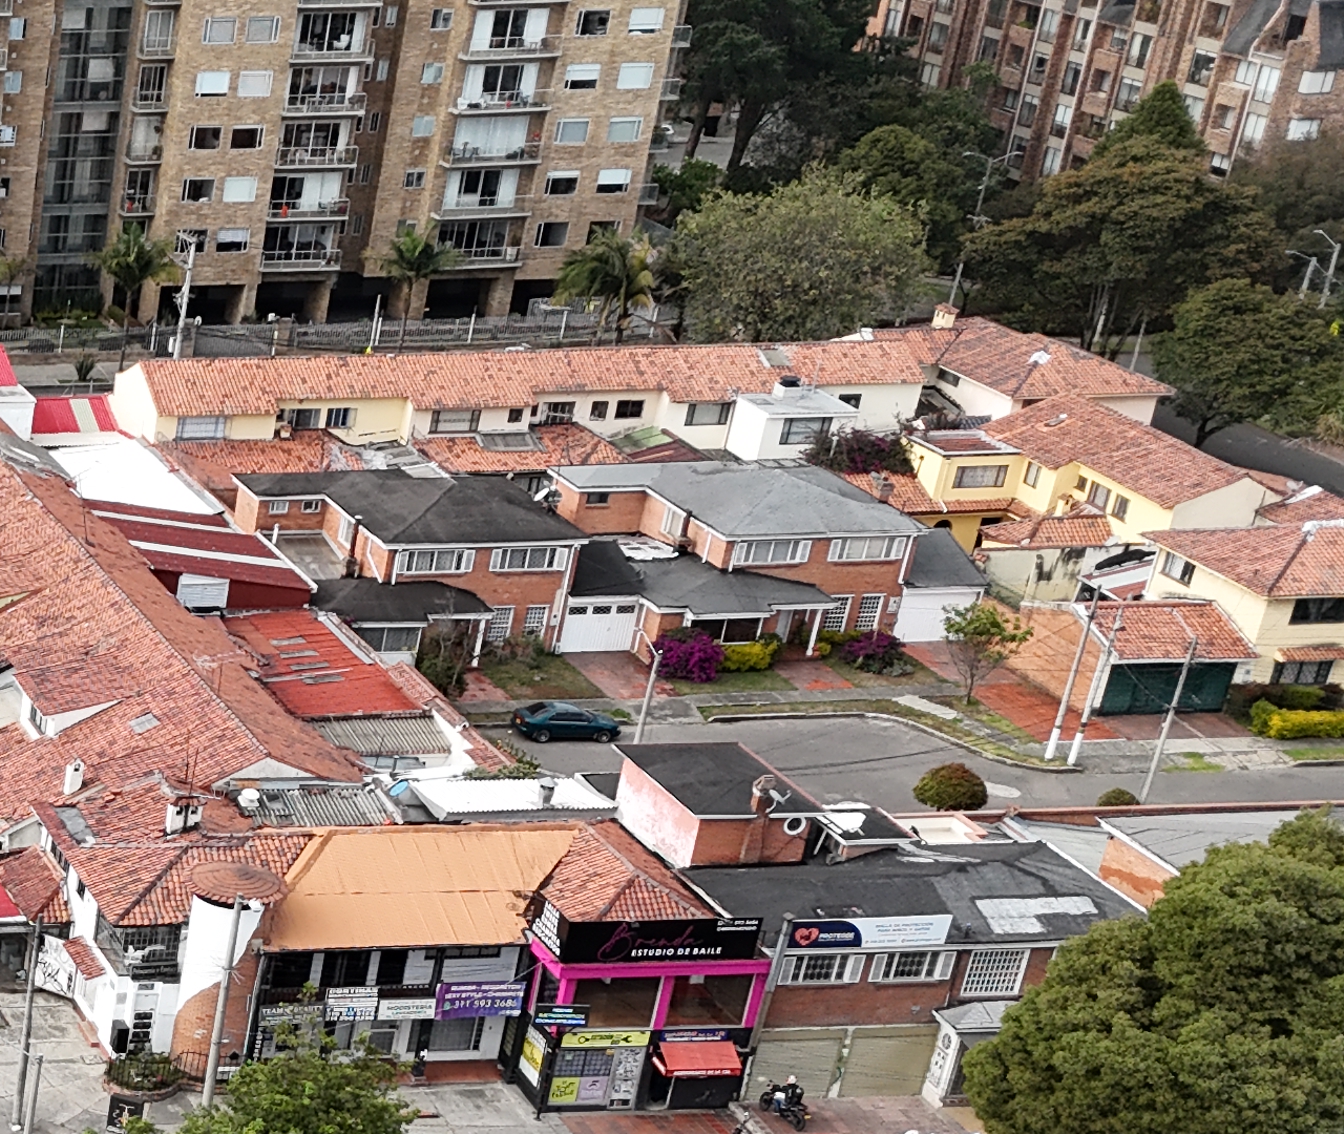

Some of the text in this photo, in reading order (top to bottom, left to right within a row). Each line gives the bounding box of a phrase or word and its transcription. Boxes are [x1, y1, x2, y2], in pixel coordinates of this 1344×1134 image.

[597, 922, 704, 961] Brenda
[631, 946, 722, 957] ESTUDIO DE BAILE
